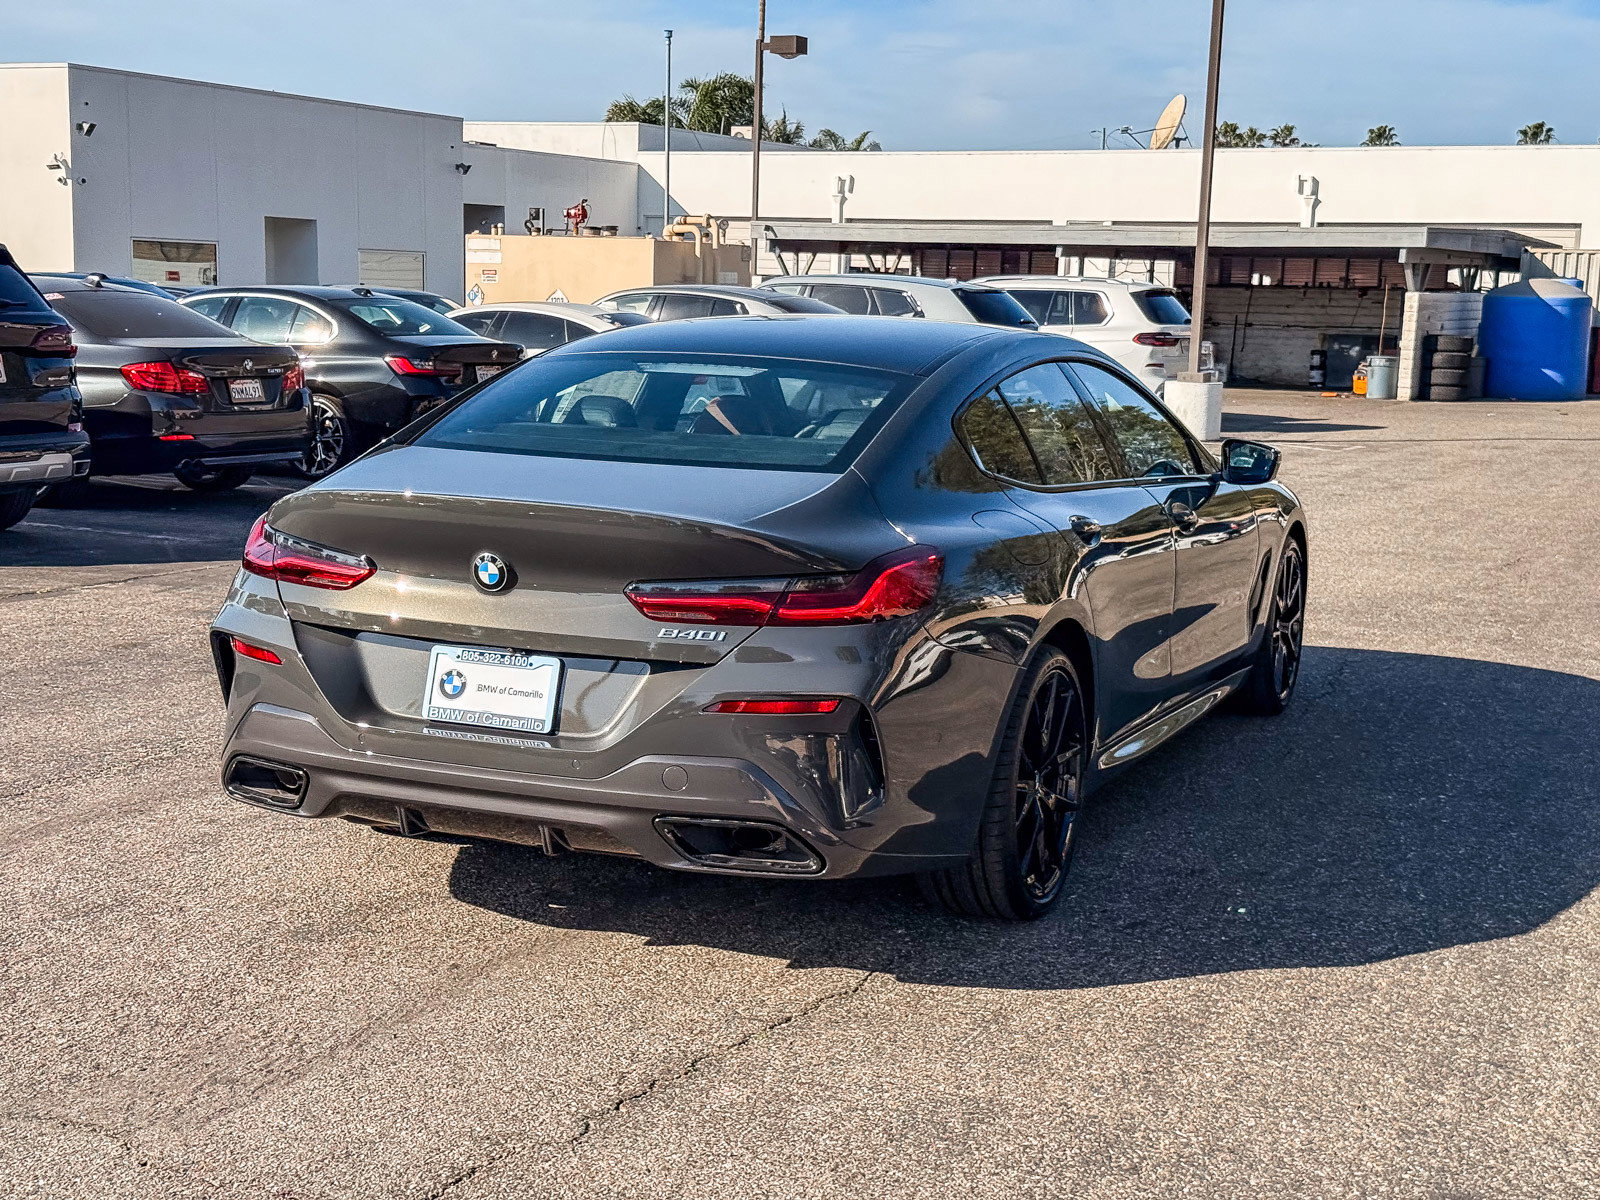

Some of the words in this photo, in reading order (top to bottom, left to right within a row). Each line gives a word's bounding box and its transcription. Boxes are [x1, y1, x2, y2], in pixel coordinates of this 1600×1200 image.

[462, 650, 528, 667] 805-322-6100
[477, 683, 498, 694] BMW
[499, 686, 507, 695] of
[508, 687, 544, 699] Camarillo
[429, 706, 464, 721] BMW
[466, 712, 480, 723] of
[482, 713, 544, 731] Camarillo
